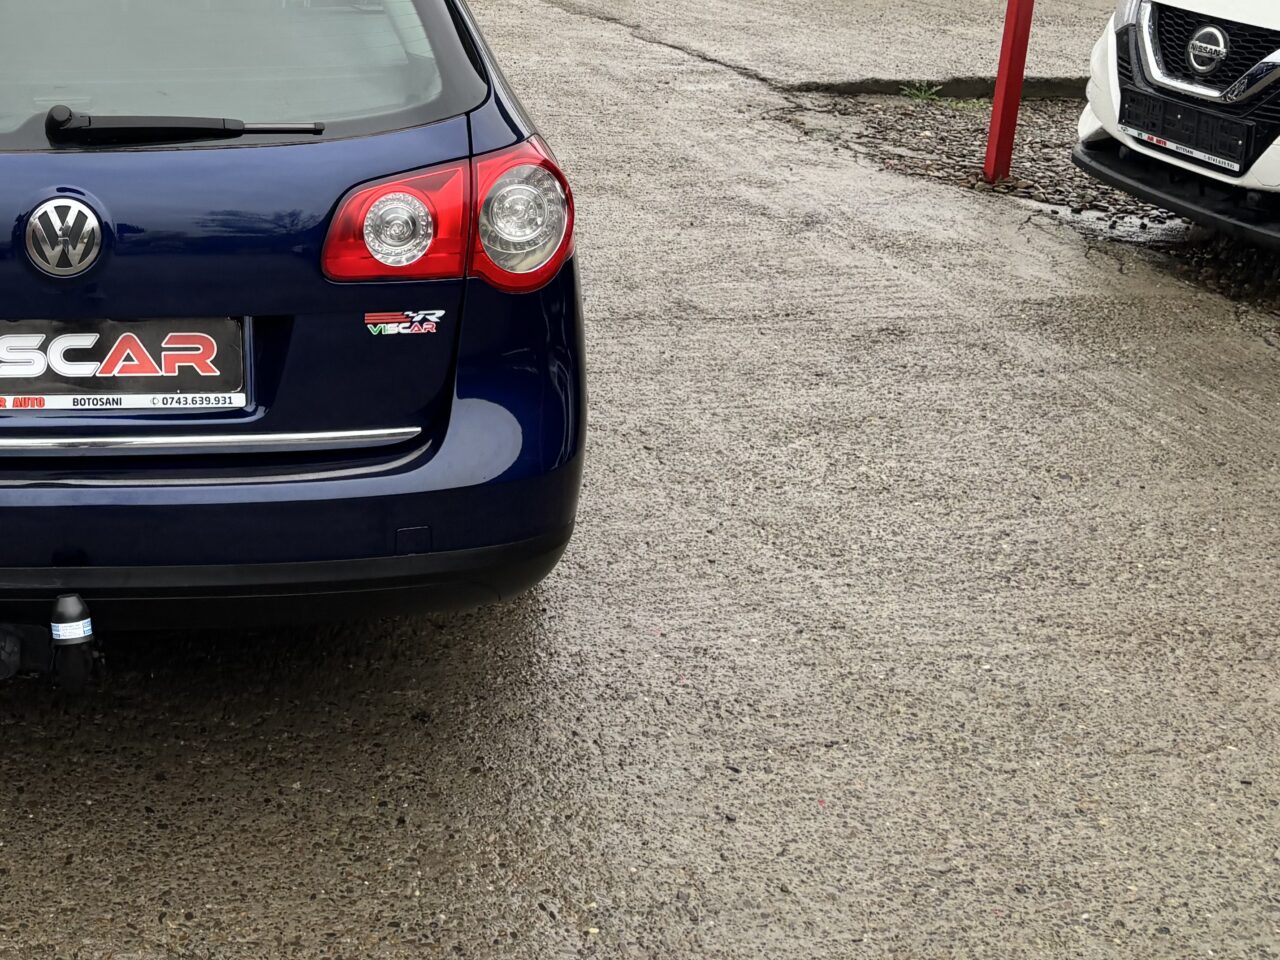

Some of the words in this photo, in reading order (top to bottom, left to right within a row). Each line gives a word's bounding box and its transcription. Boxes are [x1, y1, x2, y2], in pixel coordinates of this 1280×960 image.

[1191, 41, 1220, 57] NISSAN
[367, 322, 437, 335] VISCAR
[12, 397, 46, 408] AUTO
[72, 397, 122, 406] BOTOSANI
[161, 396, 233, 406] 0743.639.931
